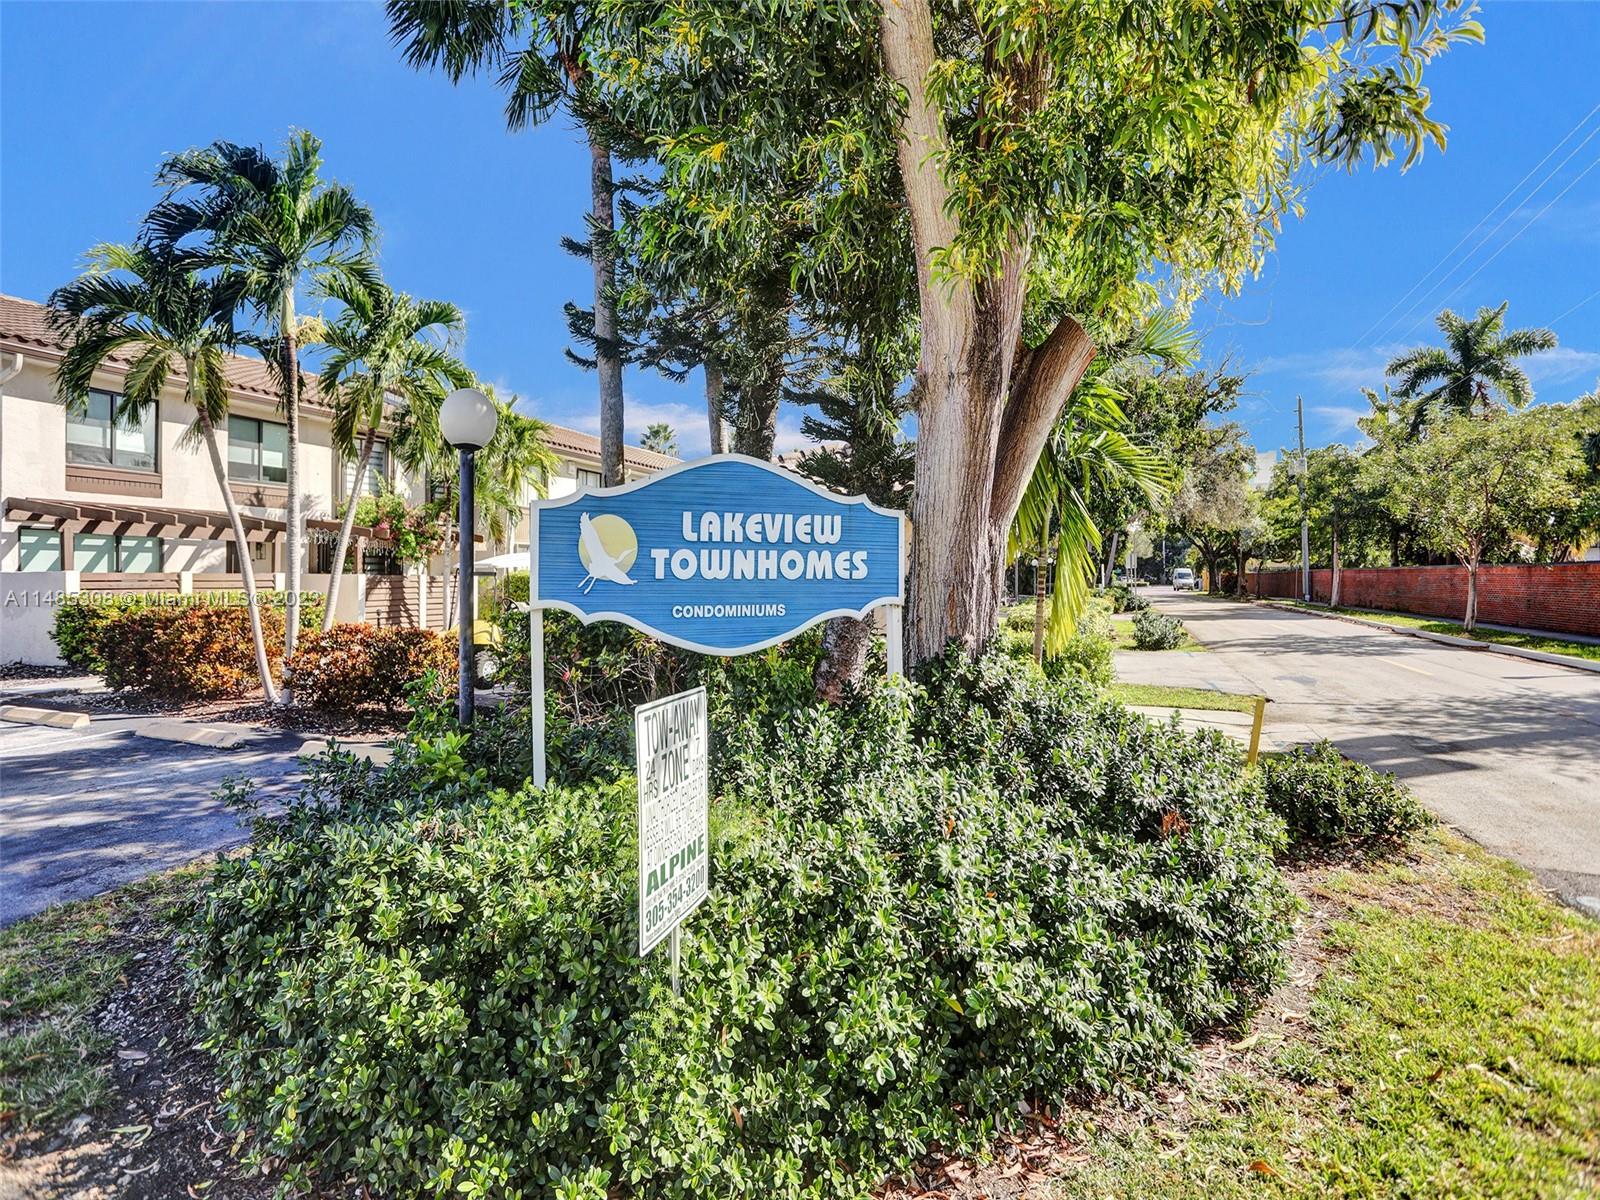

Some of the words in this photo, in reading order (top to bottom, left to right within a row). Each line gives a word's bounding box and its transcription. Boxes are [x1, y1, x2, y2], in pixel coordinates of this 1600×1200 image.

[682, 511, 842, 544] LAKEVIEW
[650, 549, 869, 581] TOWNHOMES
[672, 603, 786, 618] CONDOMINIUMS
[643, 697, 700, 758] TOW-AWAY
[661, 743, 689, 793] ZONE
[643, 778, 658, 804] HRS
[645, 832, 704, 898] ALPINE
[645, 863, 704, 934] 305-354-3200
